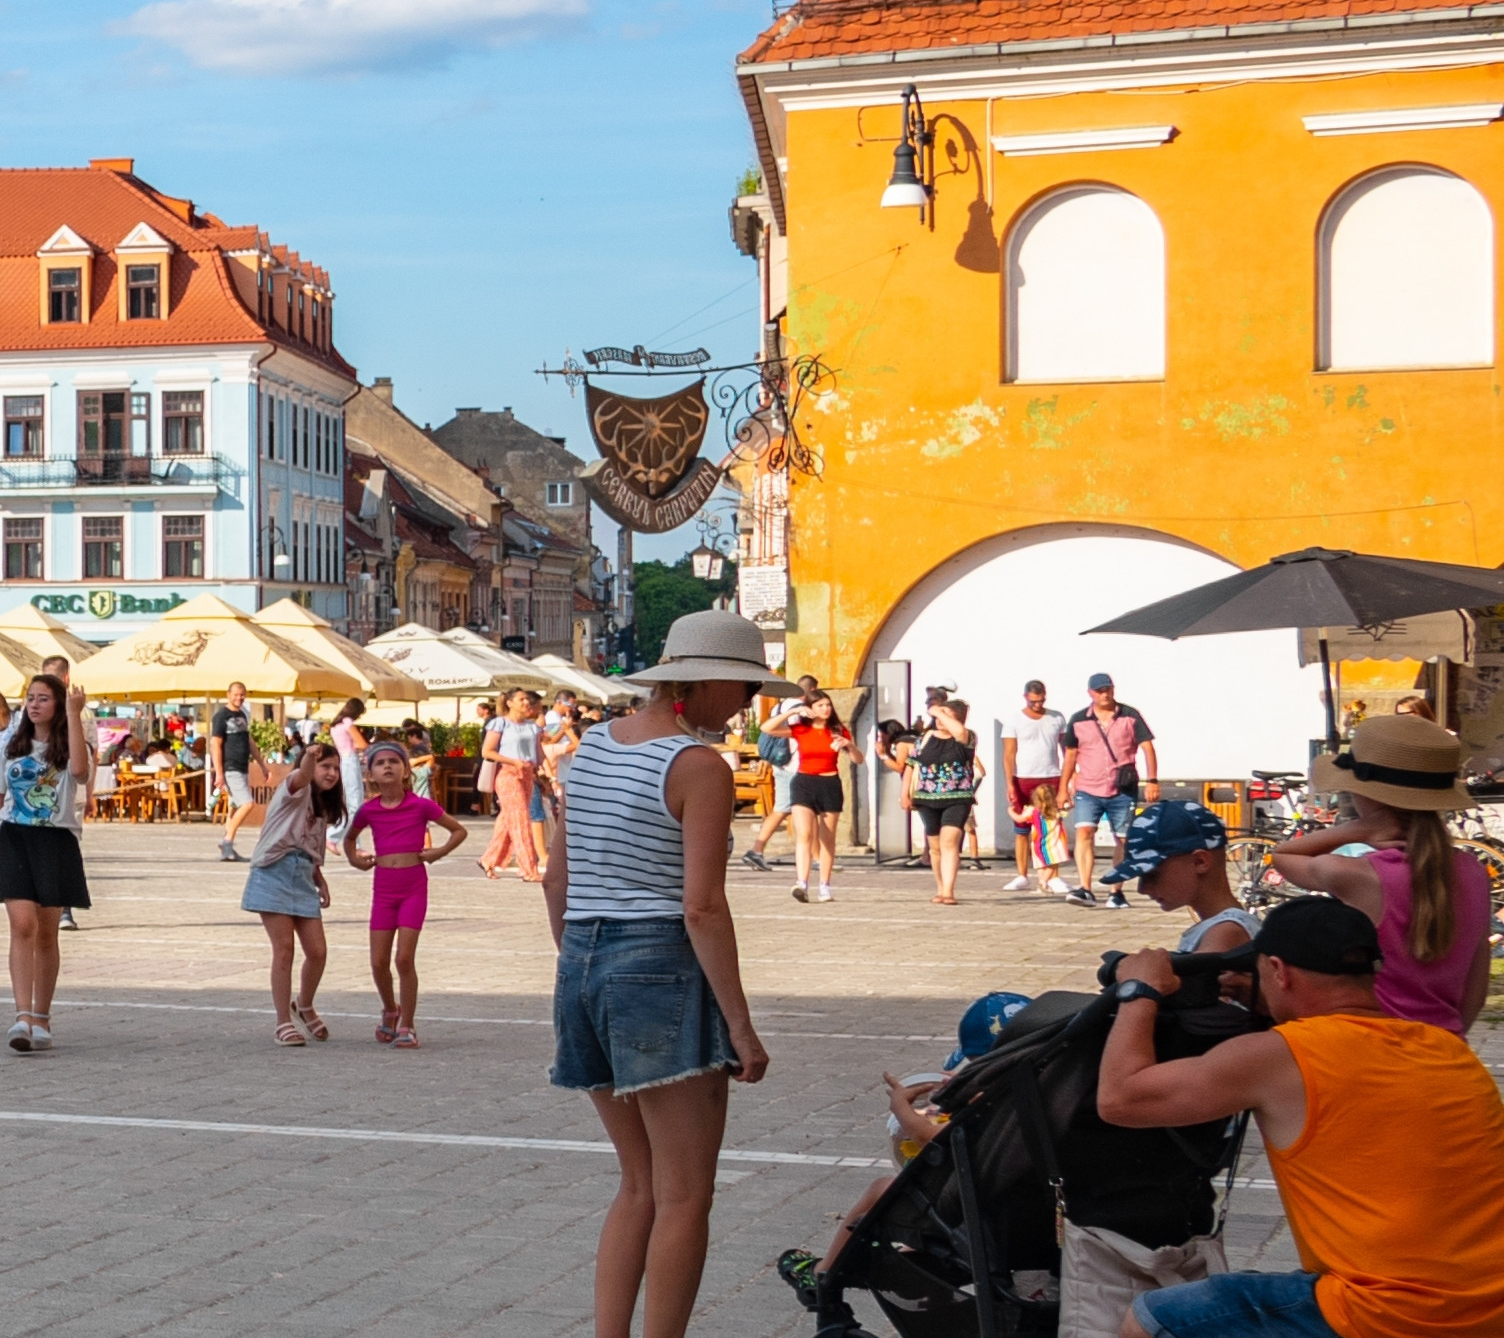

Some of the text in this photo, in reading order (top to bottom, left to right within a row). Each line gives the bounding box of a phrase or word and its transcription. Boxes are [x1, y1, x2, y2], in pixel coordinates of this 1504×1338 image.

[655, 464, 717, 530] CARPATIN
[30, 592, 188, 614] CEC Bank
